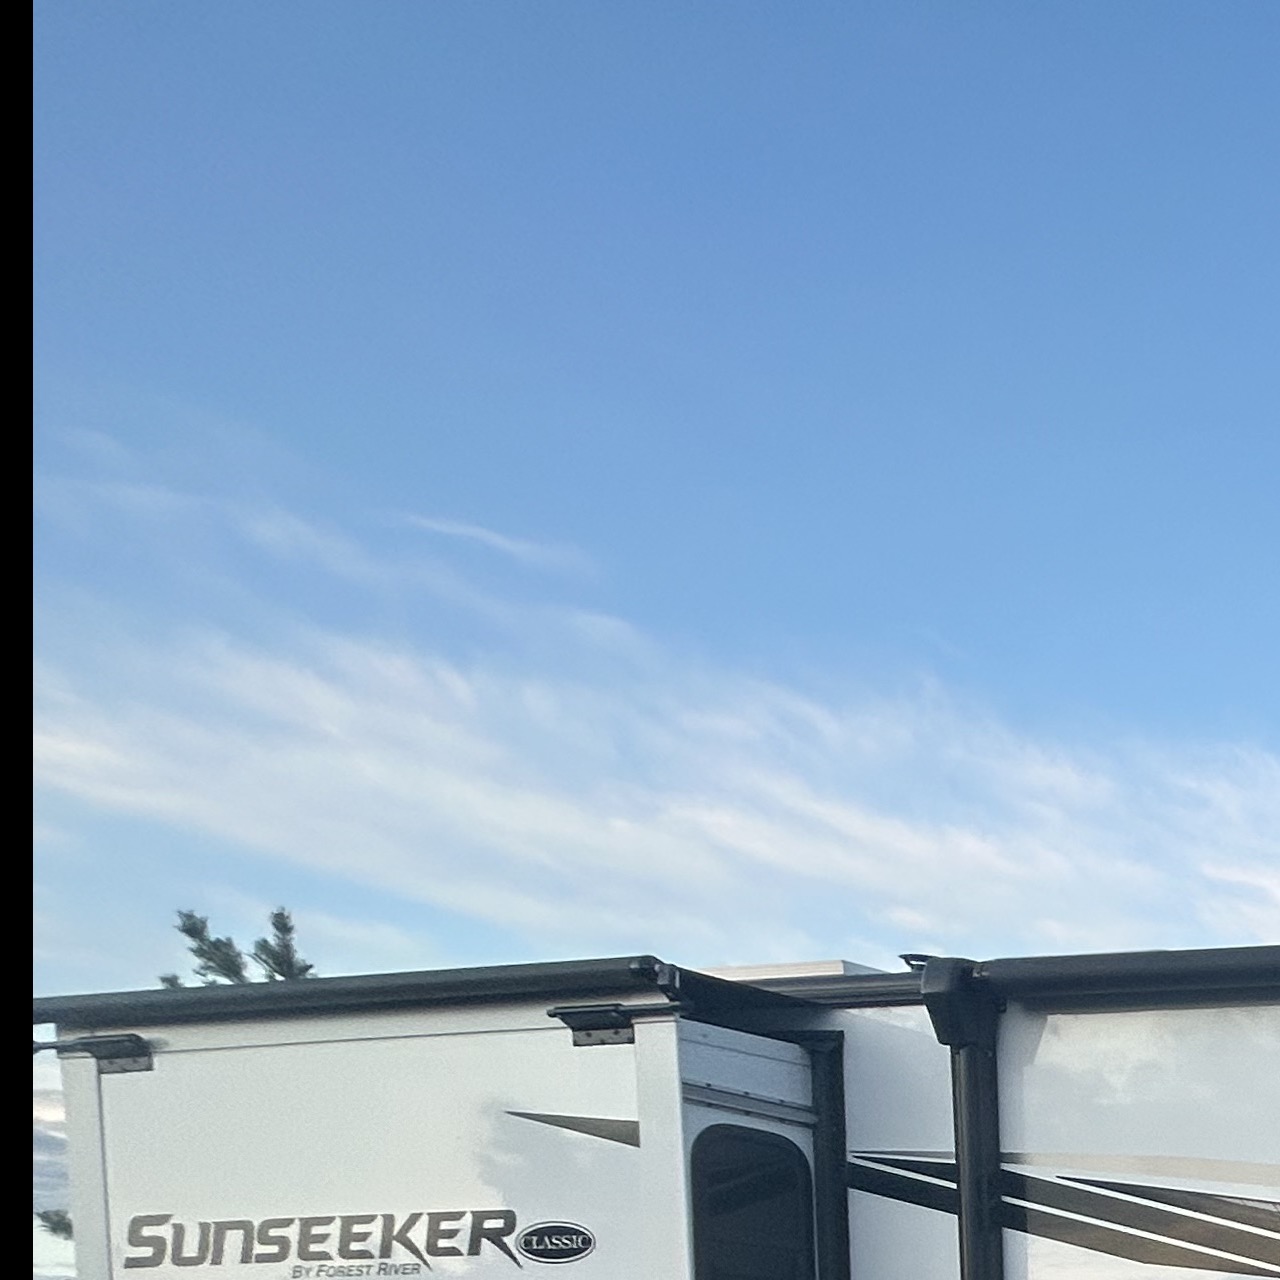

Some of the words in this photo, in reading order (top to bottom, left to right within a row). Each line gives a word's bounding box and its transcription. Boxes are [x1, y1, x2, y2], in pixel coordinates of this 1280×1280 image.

[521, 1234, 592, 1250] CLASSIC
[291, 1264, 313, 1279] BY
[315, 1264, 374, 1278] FOREST
[376, 1262, 421, 1276] RIVER
